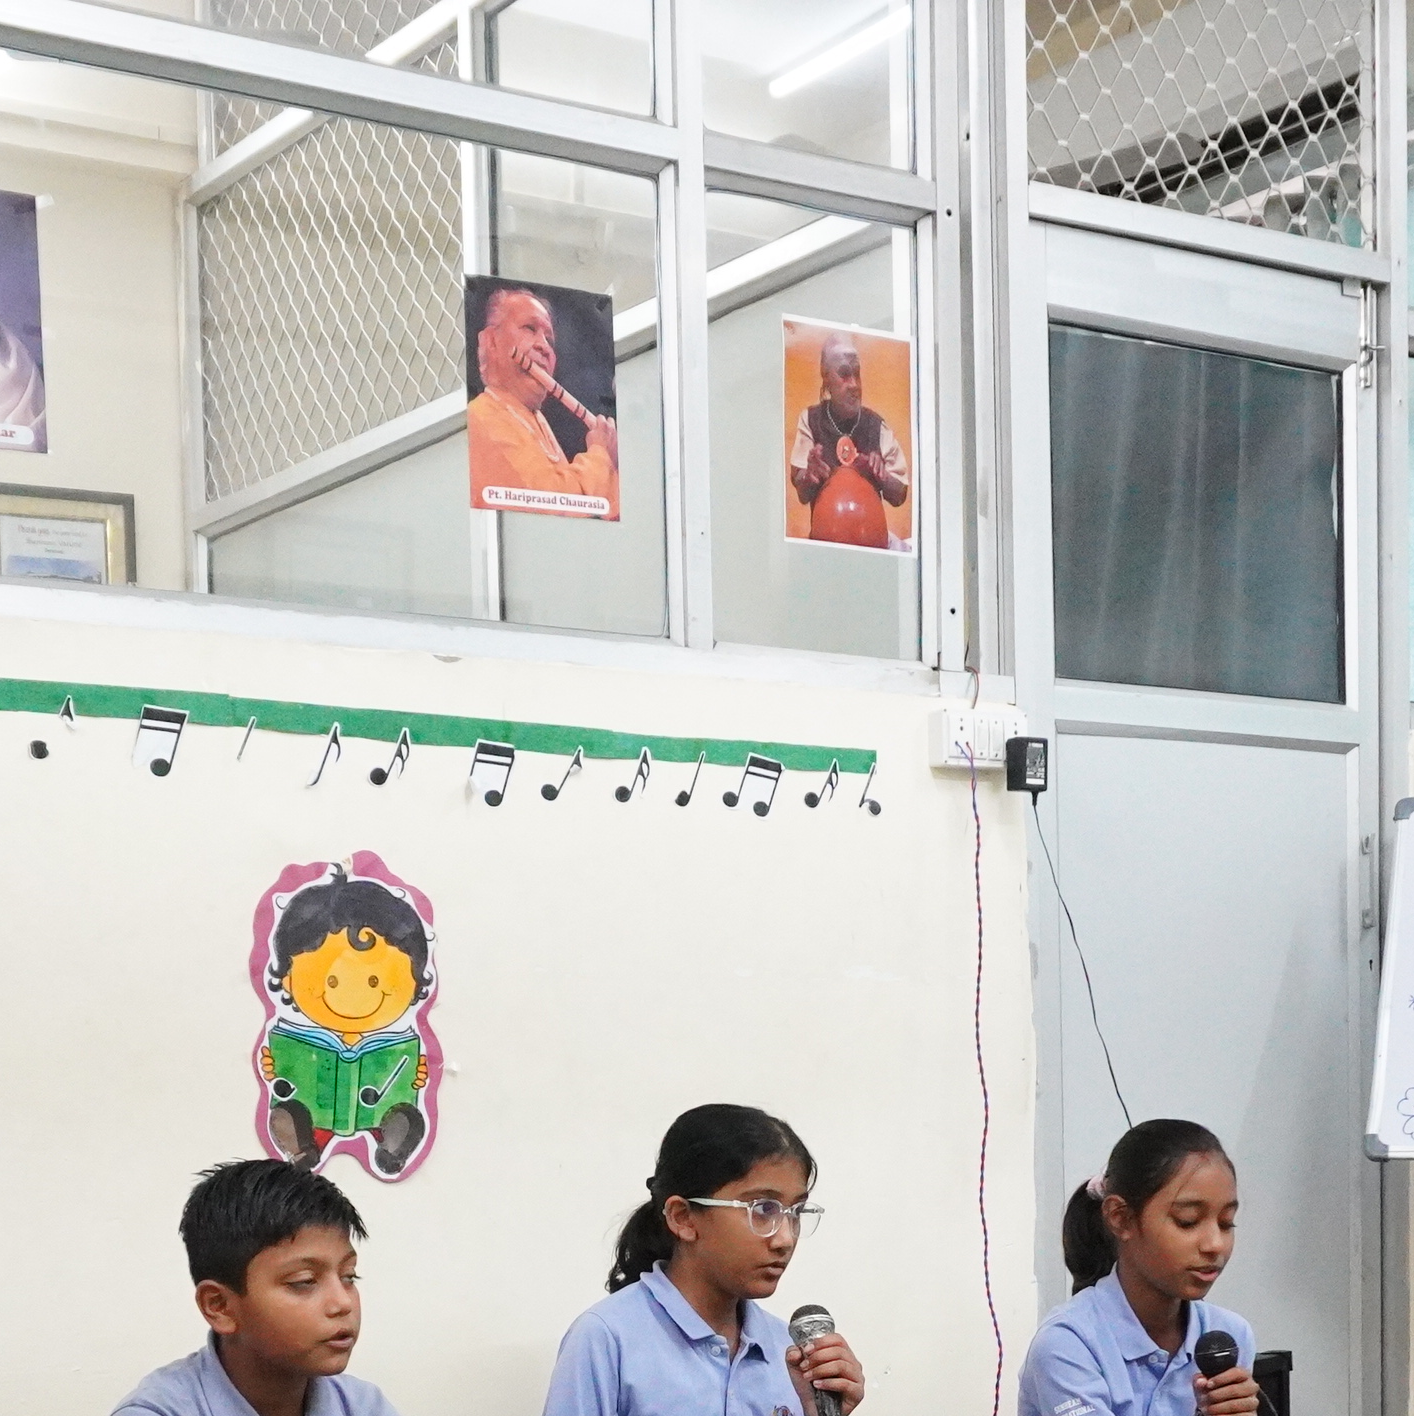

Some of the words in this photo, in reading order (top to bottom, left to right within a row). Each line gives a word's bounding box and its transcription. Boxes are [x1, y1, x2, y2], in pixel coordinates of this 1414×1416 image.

[487, 488, 502, 500] Pt.
[504, 490, 557, 505] Hariprasad
[559, 496, 605, 510] Chaurasia
